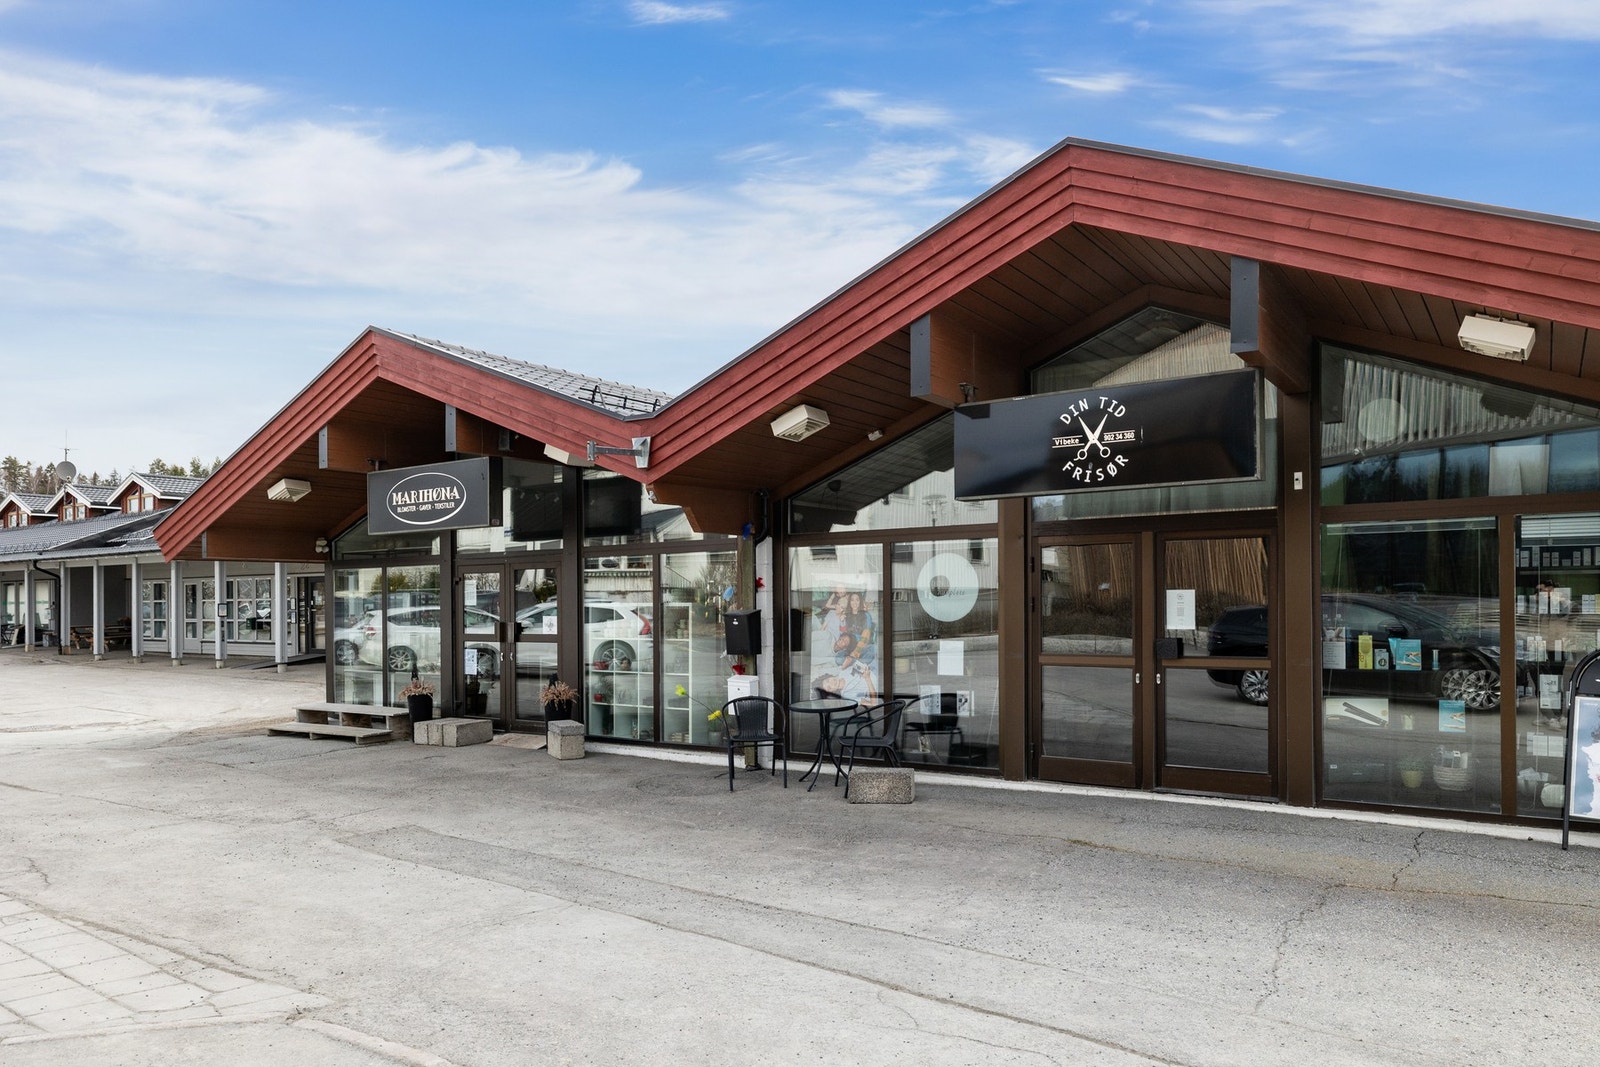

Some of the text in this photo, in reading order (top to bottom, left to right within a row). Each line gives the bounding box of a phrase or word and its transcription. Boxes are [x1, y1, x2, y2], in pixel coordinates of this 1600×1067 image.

[1059, 396, 1126, 425] DIN TID
[1062, 454, 1129, 483] FRISØR
[392, 485, 461, 506] MARIHØNA
